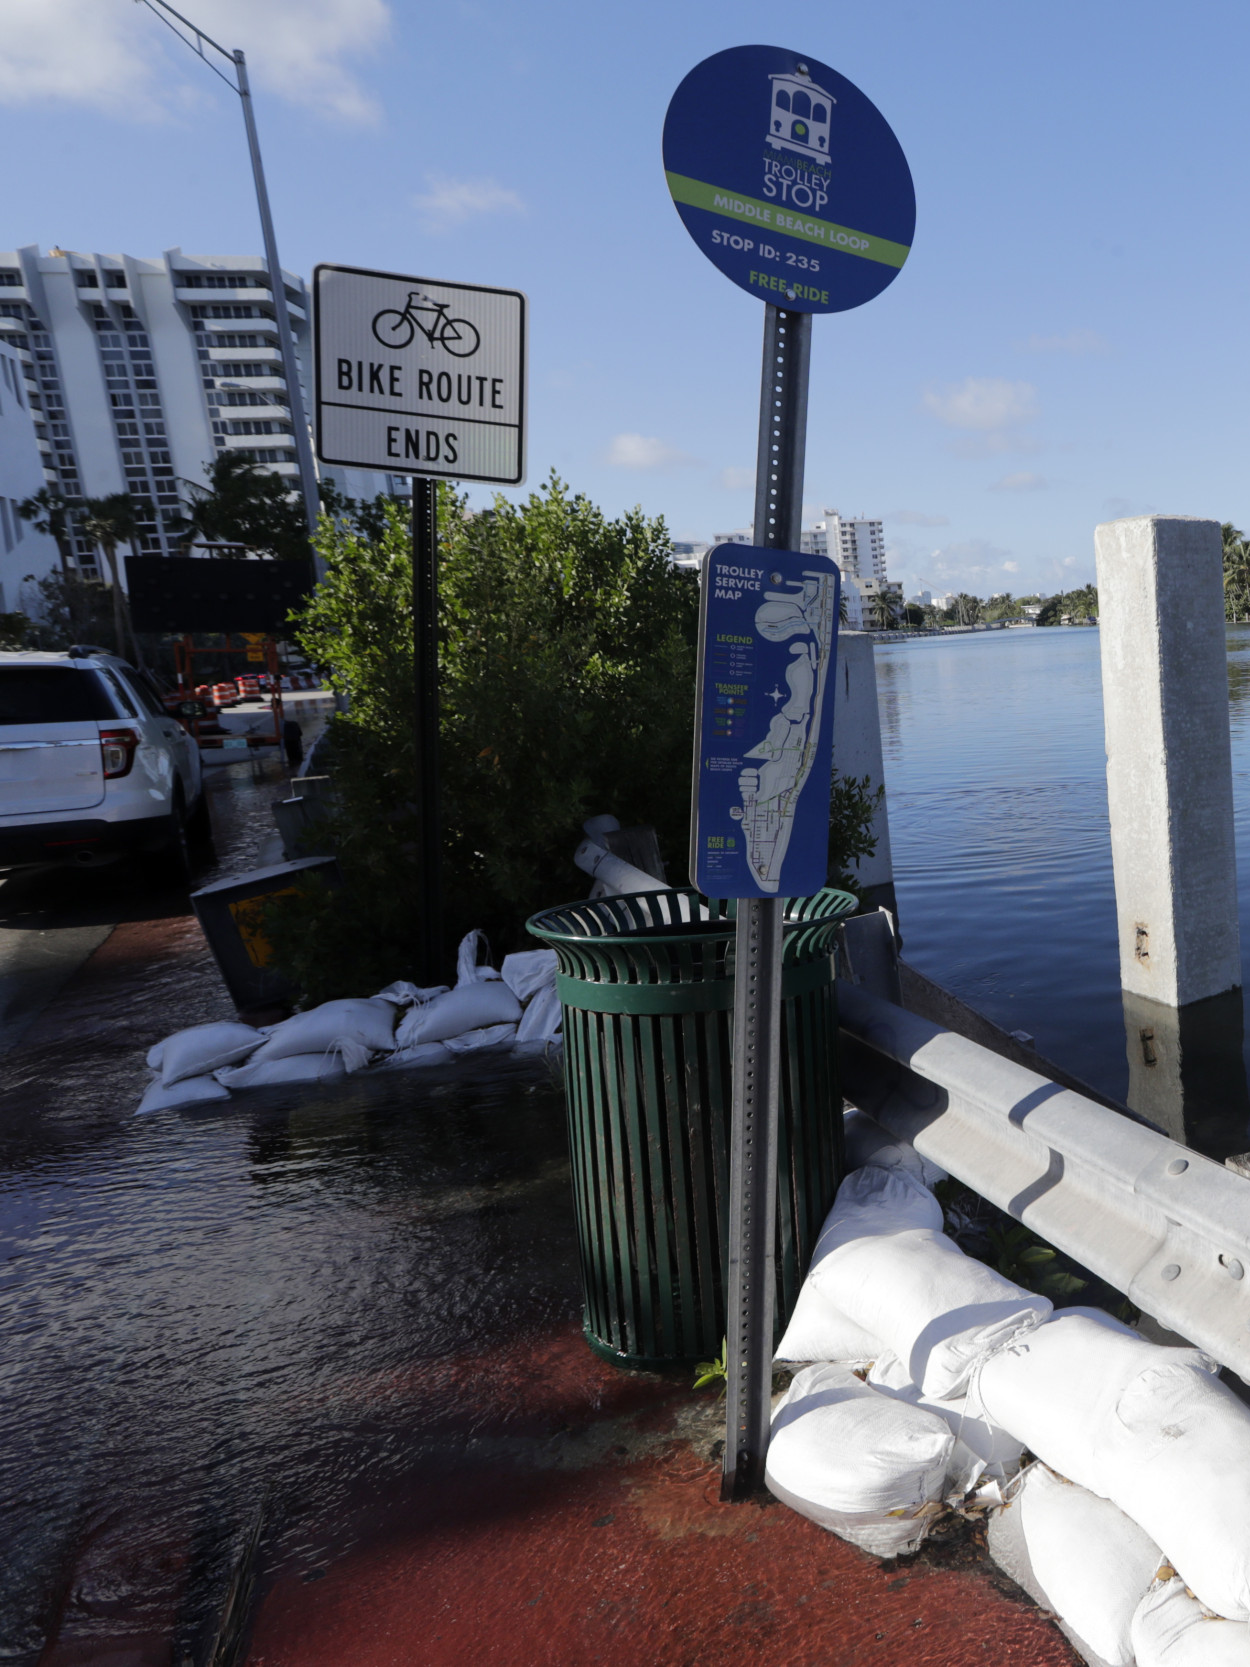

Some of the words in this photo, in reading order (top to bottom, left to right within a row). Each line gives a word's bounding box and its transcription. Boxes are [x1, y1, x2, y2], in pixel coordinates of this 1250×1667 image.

[763, 157, 831, 192] TROLLEY
[762, 173, 829, 212] STOP
[713, 193, 771, 223] MIDDLE
[776, 213, 825, 239] BEACH
[829, 229, 870, 251] LOOP
[711, 229, 754, 252] STOP
[759, 243, 781, 261] ID:
[785, 252, 820, 272] 235
[750, 270, 787, 293] FREE
[792, 282, 830, 304] RIDE
[337, 358, 403, 397] BIKE
[418, 369, 504, 409] ROUTE
[387, 425, 458, 464] ENDS
[715, 564, 764, 579] TROLLEY
[715, 576, 761, 591] SERVICE
[714, 588, 742, 600] MAP
[716, 633, 753, 645] LEGEND
